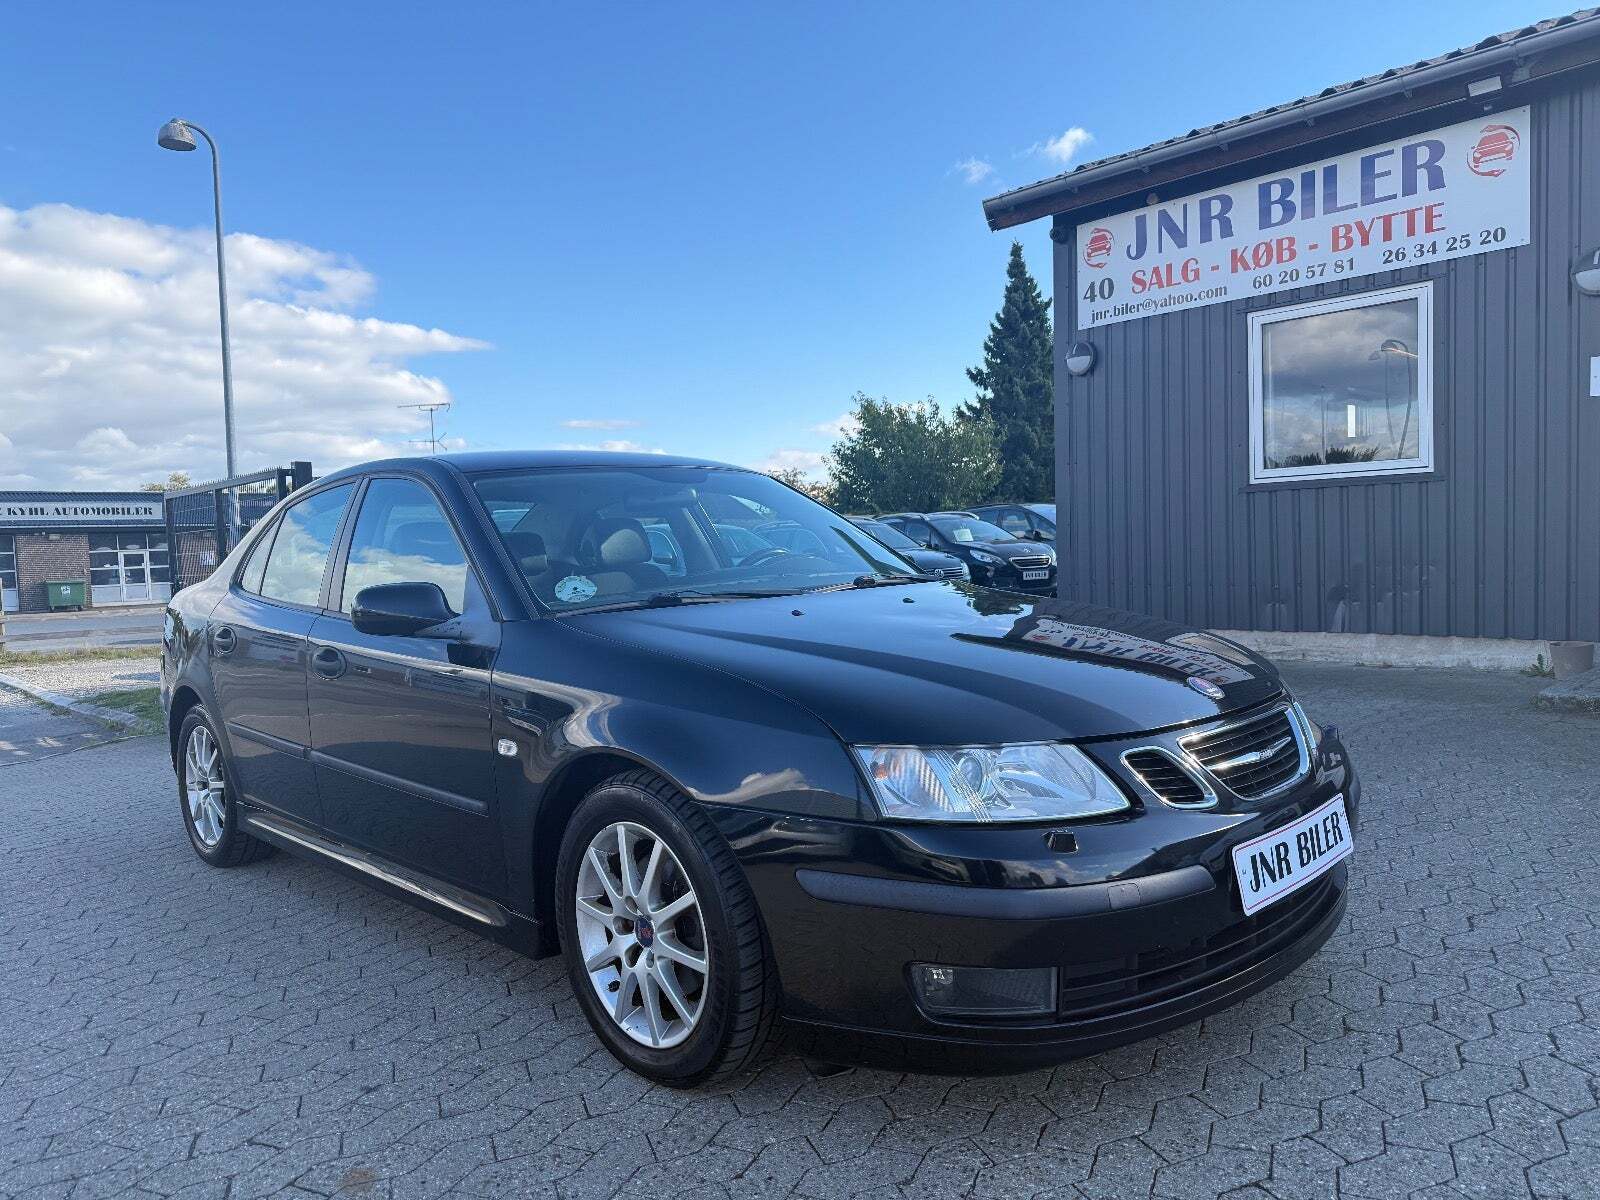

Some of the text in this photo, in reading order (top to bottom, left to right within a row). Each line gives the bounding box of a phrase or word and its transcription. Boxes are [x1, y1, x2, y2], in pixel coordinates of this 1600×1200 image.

[1126, 139, 1447, 261] JNR BILER
[1131, 258, 1201, 295] SALG
[1230, 236, 1298, 275] KØB
[1331, 202, 1447, 253] BYTTE
[1252, 226, 1507, 290] 60 20 57 81 26 34 25 20
[1083, 277, 1115, 303] 40
[1091, 285, 1228, 324] jnr.biler@yahoo.com
[52, 506, 153, 516] AUTOMOBILER
[1250, 811, 1344, 892] JNR BILER
